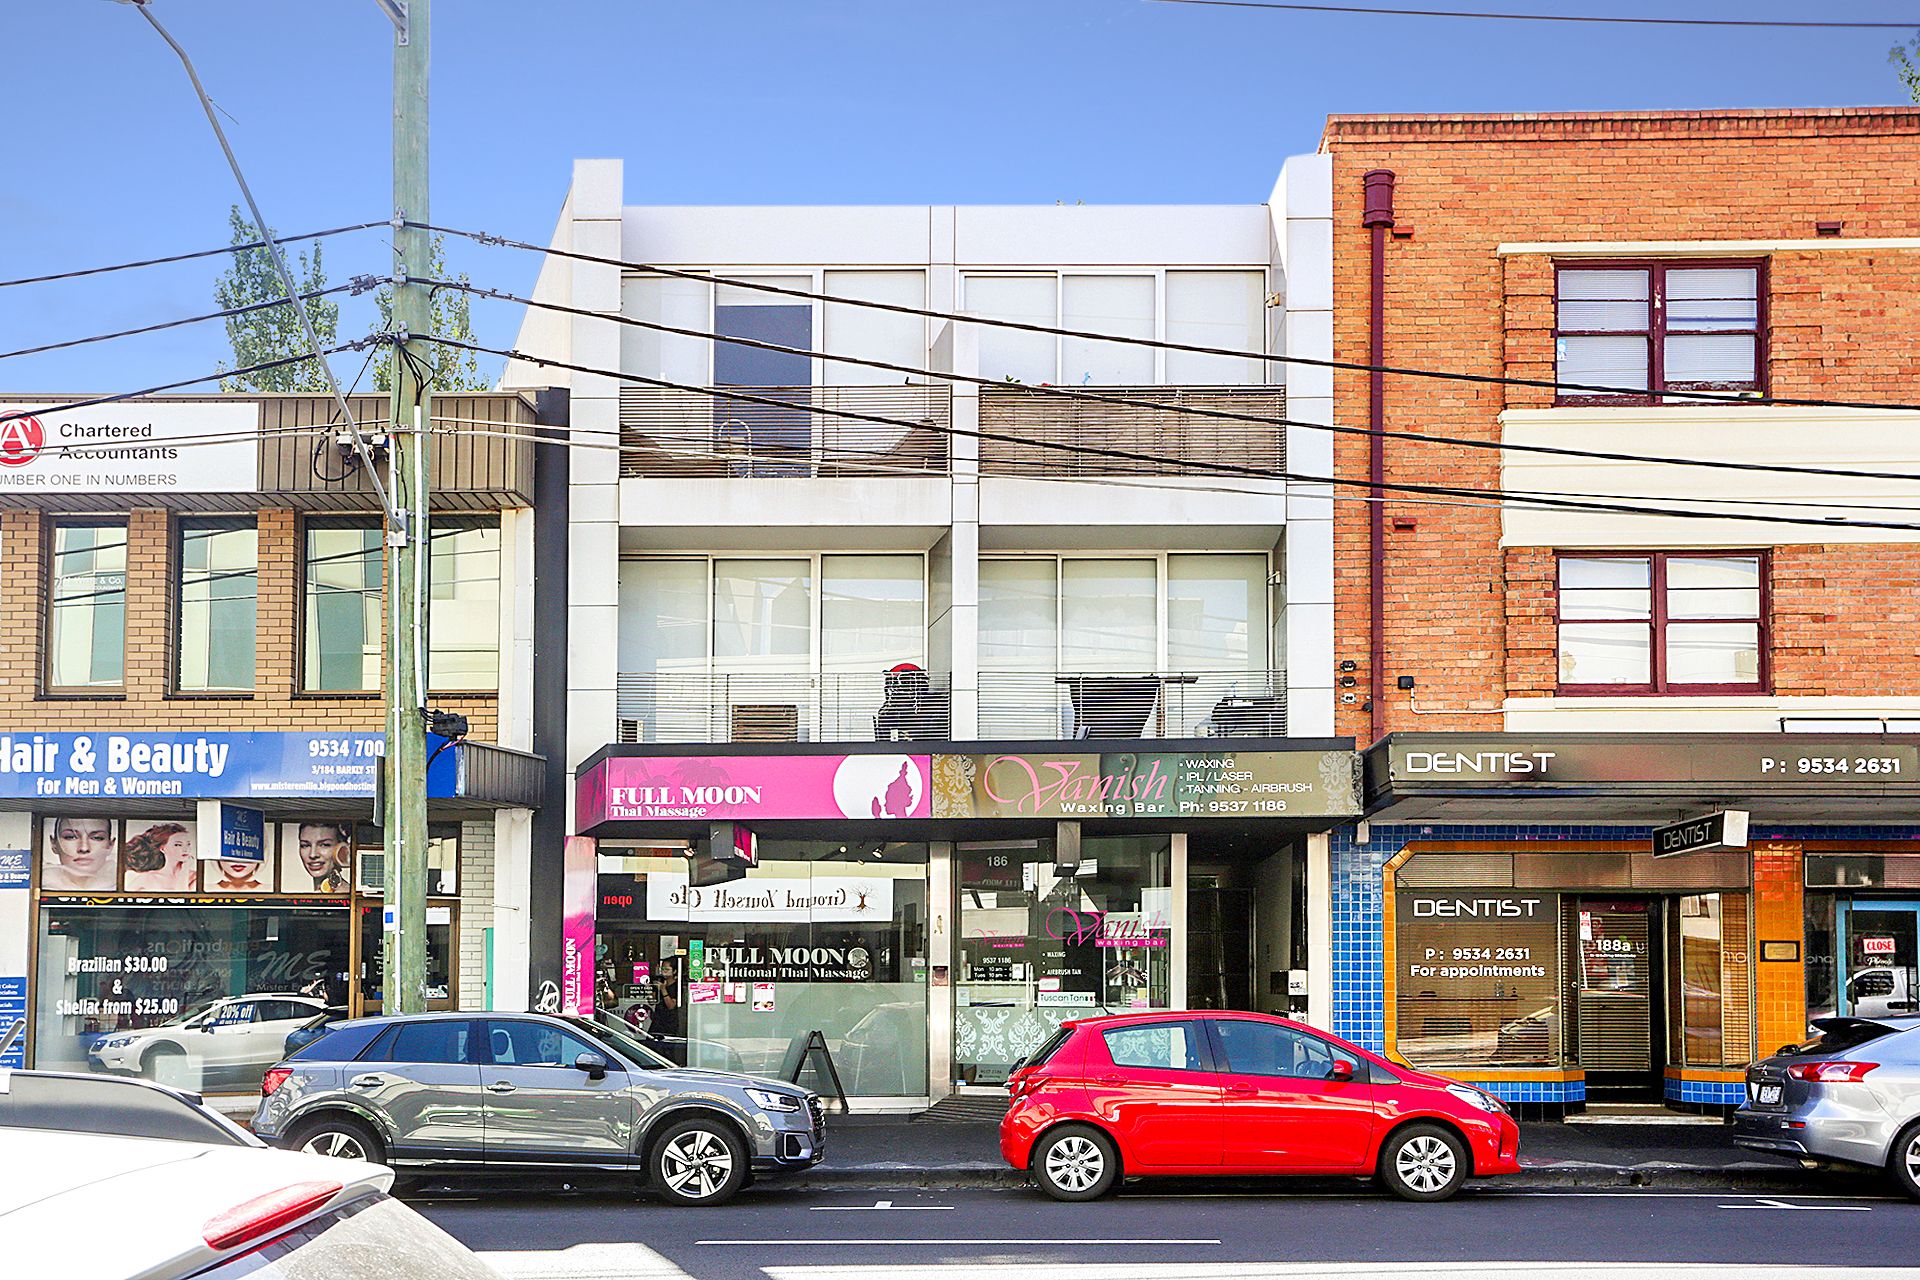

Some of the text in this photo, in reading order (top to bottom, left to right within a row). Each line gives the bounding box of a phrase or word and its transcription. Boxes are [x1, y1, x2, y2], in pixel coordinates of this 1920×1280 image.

[59, 423, 153, 438] Chartered
[58, 446, 179, 460] Accountants
[0, 474, 178, 486] MBER ONE IN NUMBERS
[308, 740, 350, 757] 9534
[69, 735, 97, 774] &
[107, 736, 230, 778] Beauty
[1185, 759, 1235, 769] WAXING
[1405, 752, 1557, 773] DENTIST
[1797, 757, 1849, 774] 9534
[1854, 757, 1901, 774] 2631
[1186, 772, 1205, 781] IPL
[1213, 771, 1253, 781] LASER
[36, 777, 183, 795] for Men & Women
[983, 755, 1169, 814] Vanish
[1185, 784, 1241, 794] TANNING
[1250, 783, 1313, 793] AIRBRUSH
[610, 785, 763, 806] FULL MOON
[611, 806, 707, 819] Thai Massage
[1060, 802, 1166, 815] Waxing Bar
[1179, 800, 1287, 813] Ph: 9537 1186
[1663, 821, 1713, 850] DENTIST
[986, 856, 1008, 867] 186
[1413, 899, 1541, 917] DENTIST
[1045, 906, 1166, 947] Vanish
[1097, 939, 1139, 948] waxing
[1595, 939, 1632, 952] 188a
[1866, 940, 1894, 951] CLOSE
[565, 937, 577, 976] MOON
[704, 947, 846, 965] FULL MOON
[1452, 947, 1492, 961] 9534
[1495, 947, 1530, 961] 2631
[67, 957, 122, 973] Brazilian
[124, 956, 168, 974] $30.00
[1410, 964, 1546, 979] For appointments
[703, 966, 869, 980] Traditional Thai Massage
[112, 978, 124, 995] &
[55, 998, 178, 1016] Shellac from $25.00
